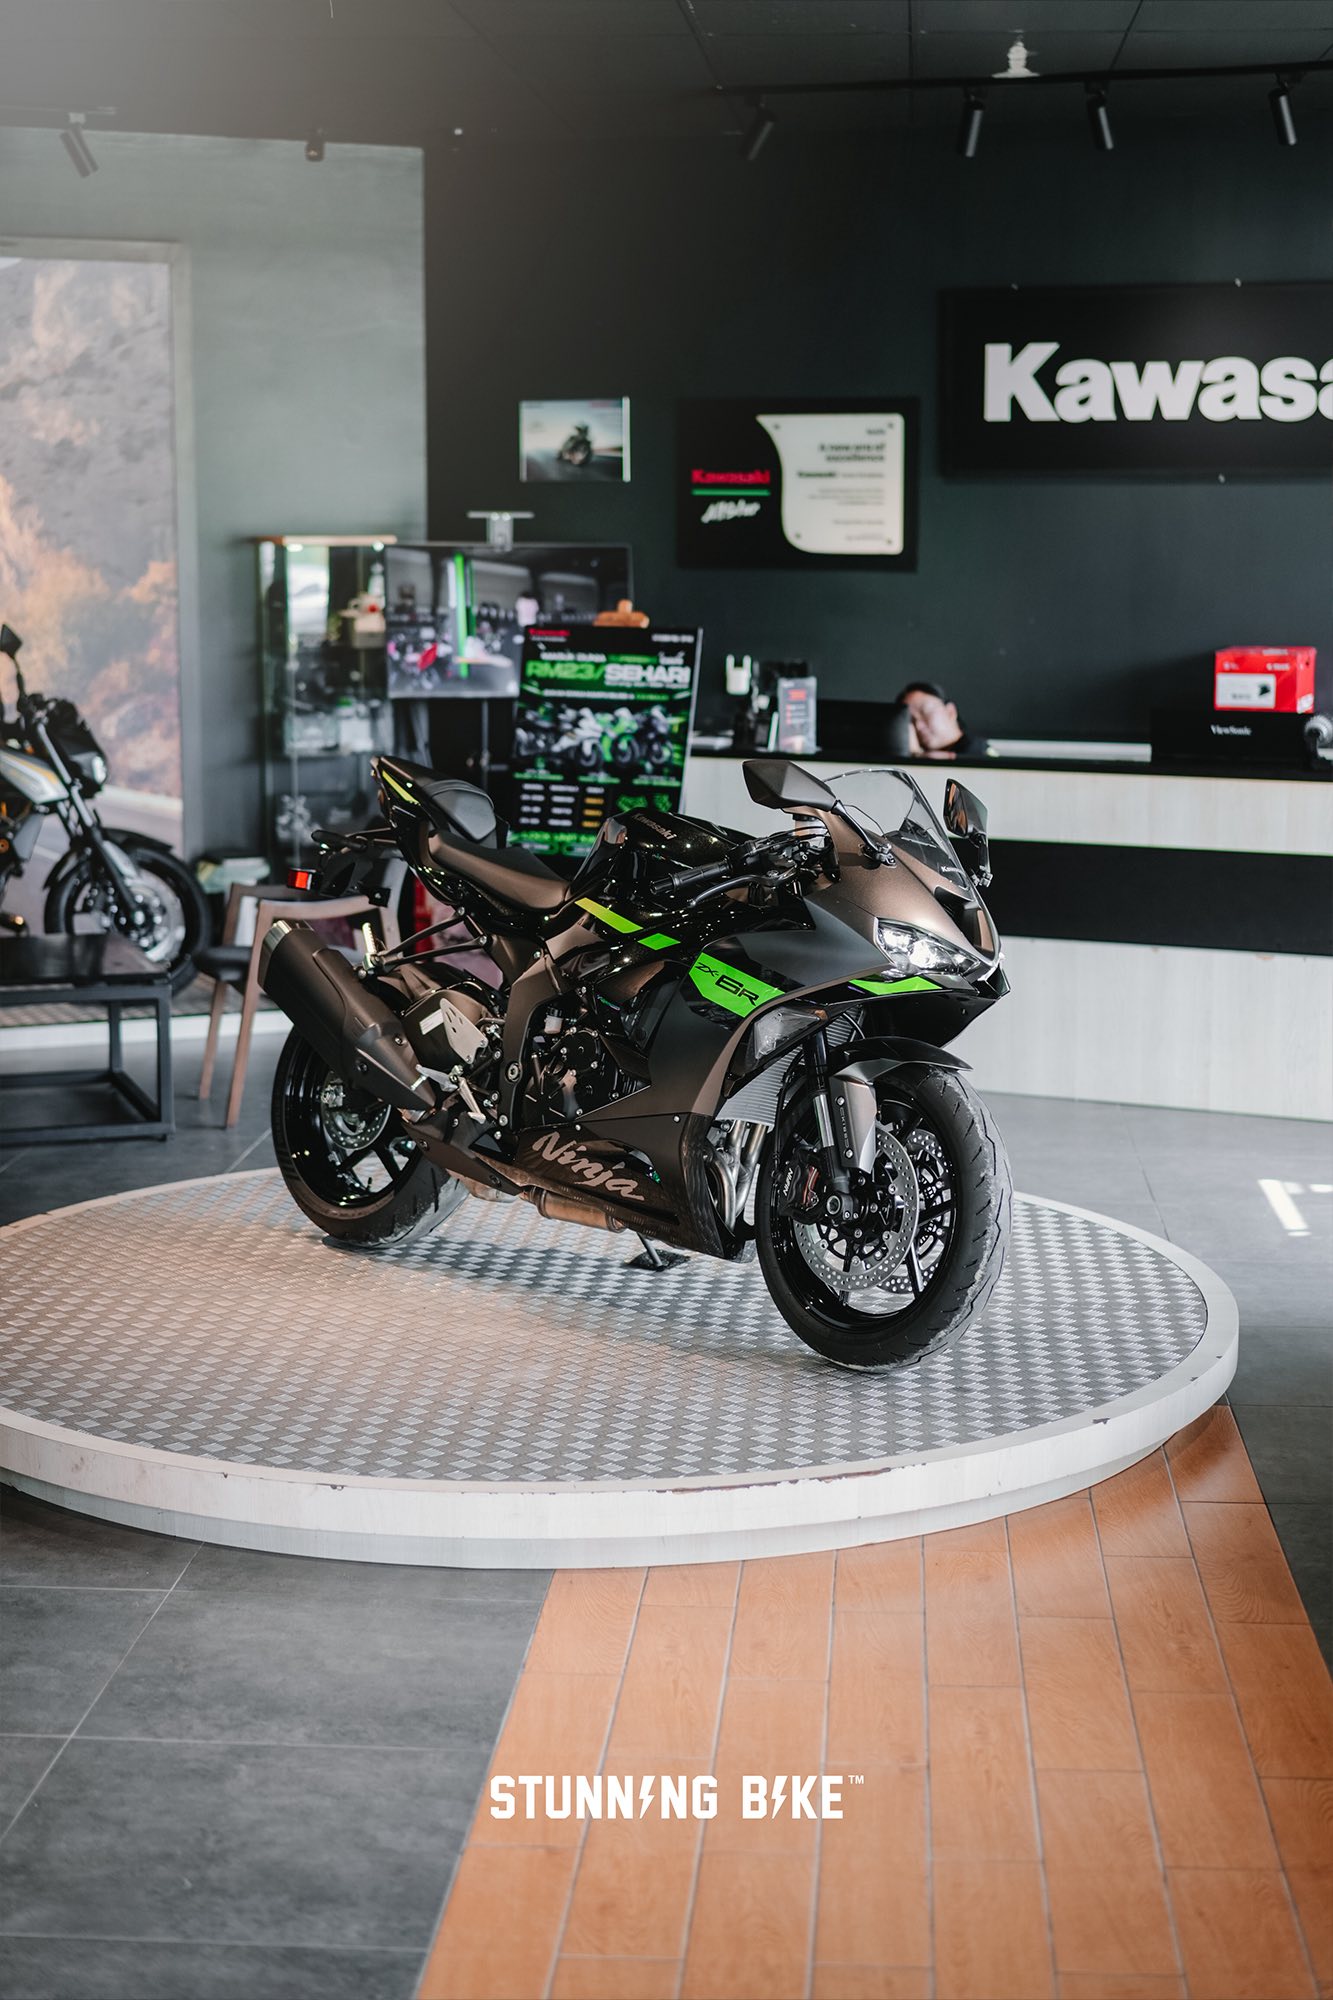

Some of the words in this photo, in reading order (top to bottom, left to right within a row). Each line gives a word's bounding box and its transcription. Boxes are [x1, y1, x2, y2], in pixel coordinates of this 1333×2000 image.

[983, 342, 1333, 423] Kawas
[692, 469, 770, 485] Kawasaki
[1211, 725, 1251, 735] ViewSonic
[632, 813, 677, 840] Kawasaki
[531, 1131, 645, 1201] Ninja
